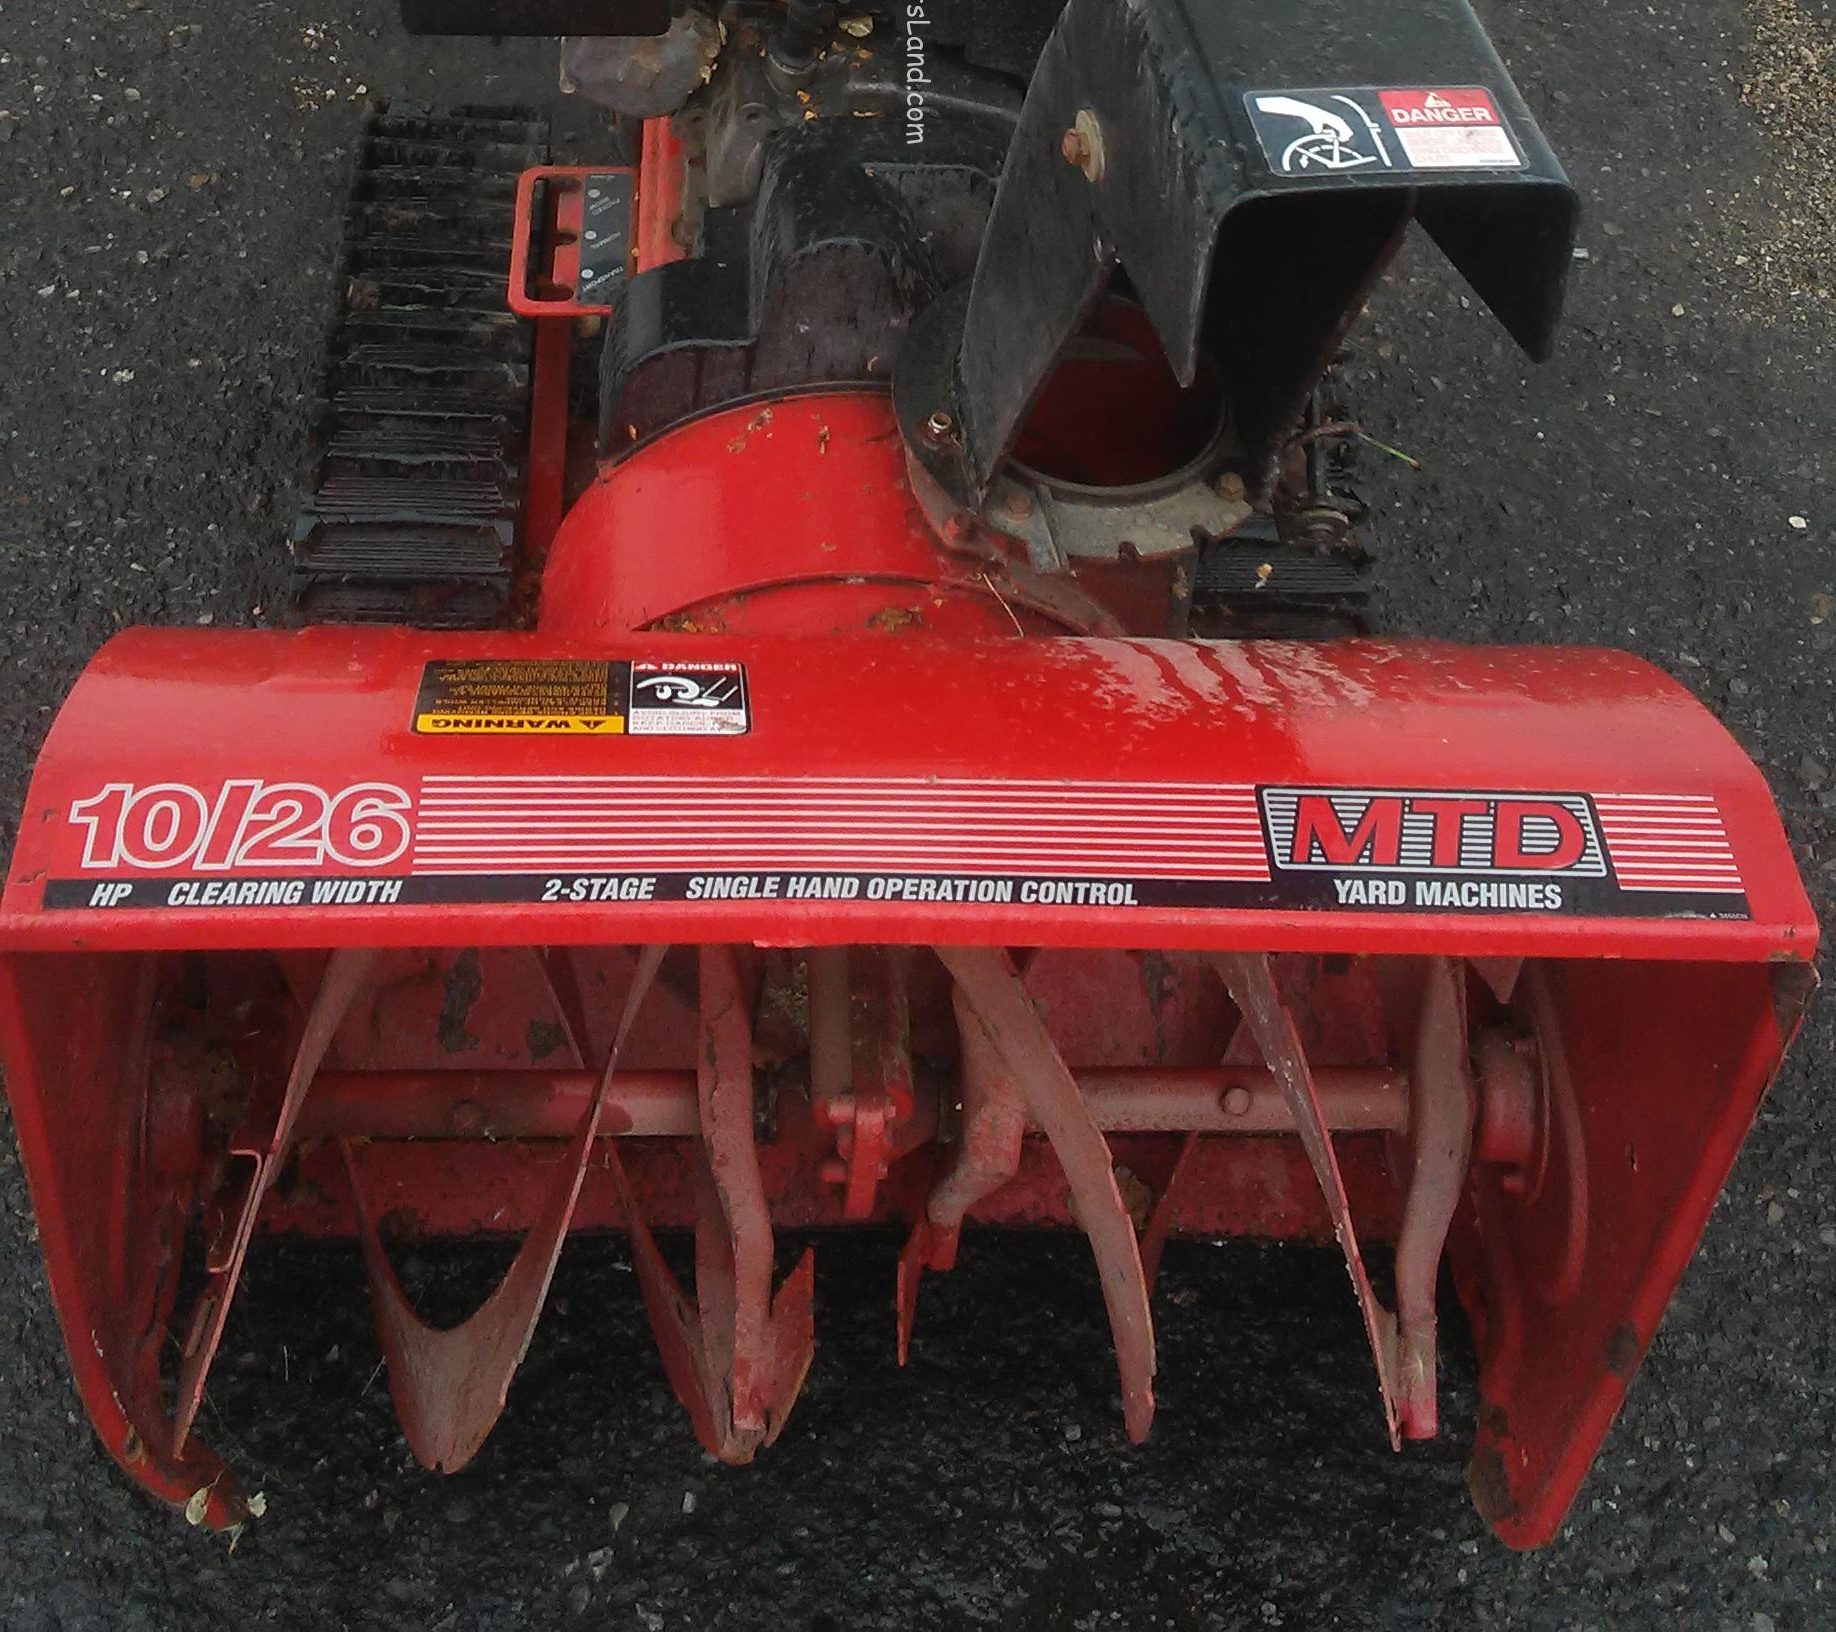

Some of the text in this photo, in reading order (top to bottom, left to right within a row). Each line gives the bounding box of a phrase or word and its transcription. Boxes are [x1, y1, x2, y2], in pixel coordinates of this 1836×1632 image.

[1390, 106, 1493, 125] DANGER
[582, 265, 624, 293] TRANSPORT
[661, 662, 738, 671] DANGER
[431, 719, 571, 729] WARNING
[68, 779, 412, 870] 10/26
[1293, 796, 1587, 868] MTD
[90, 880, 403, 907] HP CLEARING WIDTH
[542, 878, 657, 901] 2-STAGE
[686, 876, 1139, 907] SINGLE HAND OPERATION CONTROL
[1334, 878, 1563, 909] YARD MACHINES
